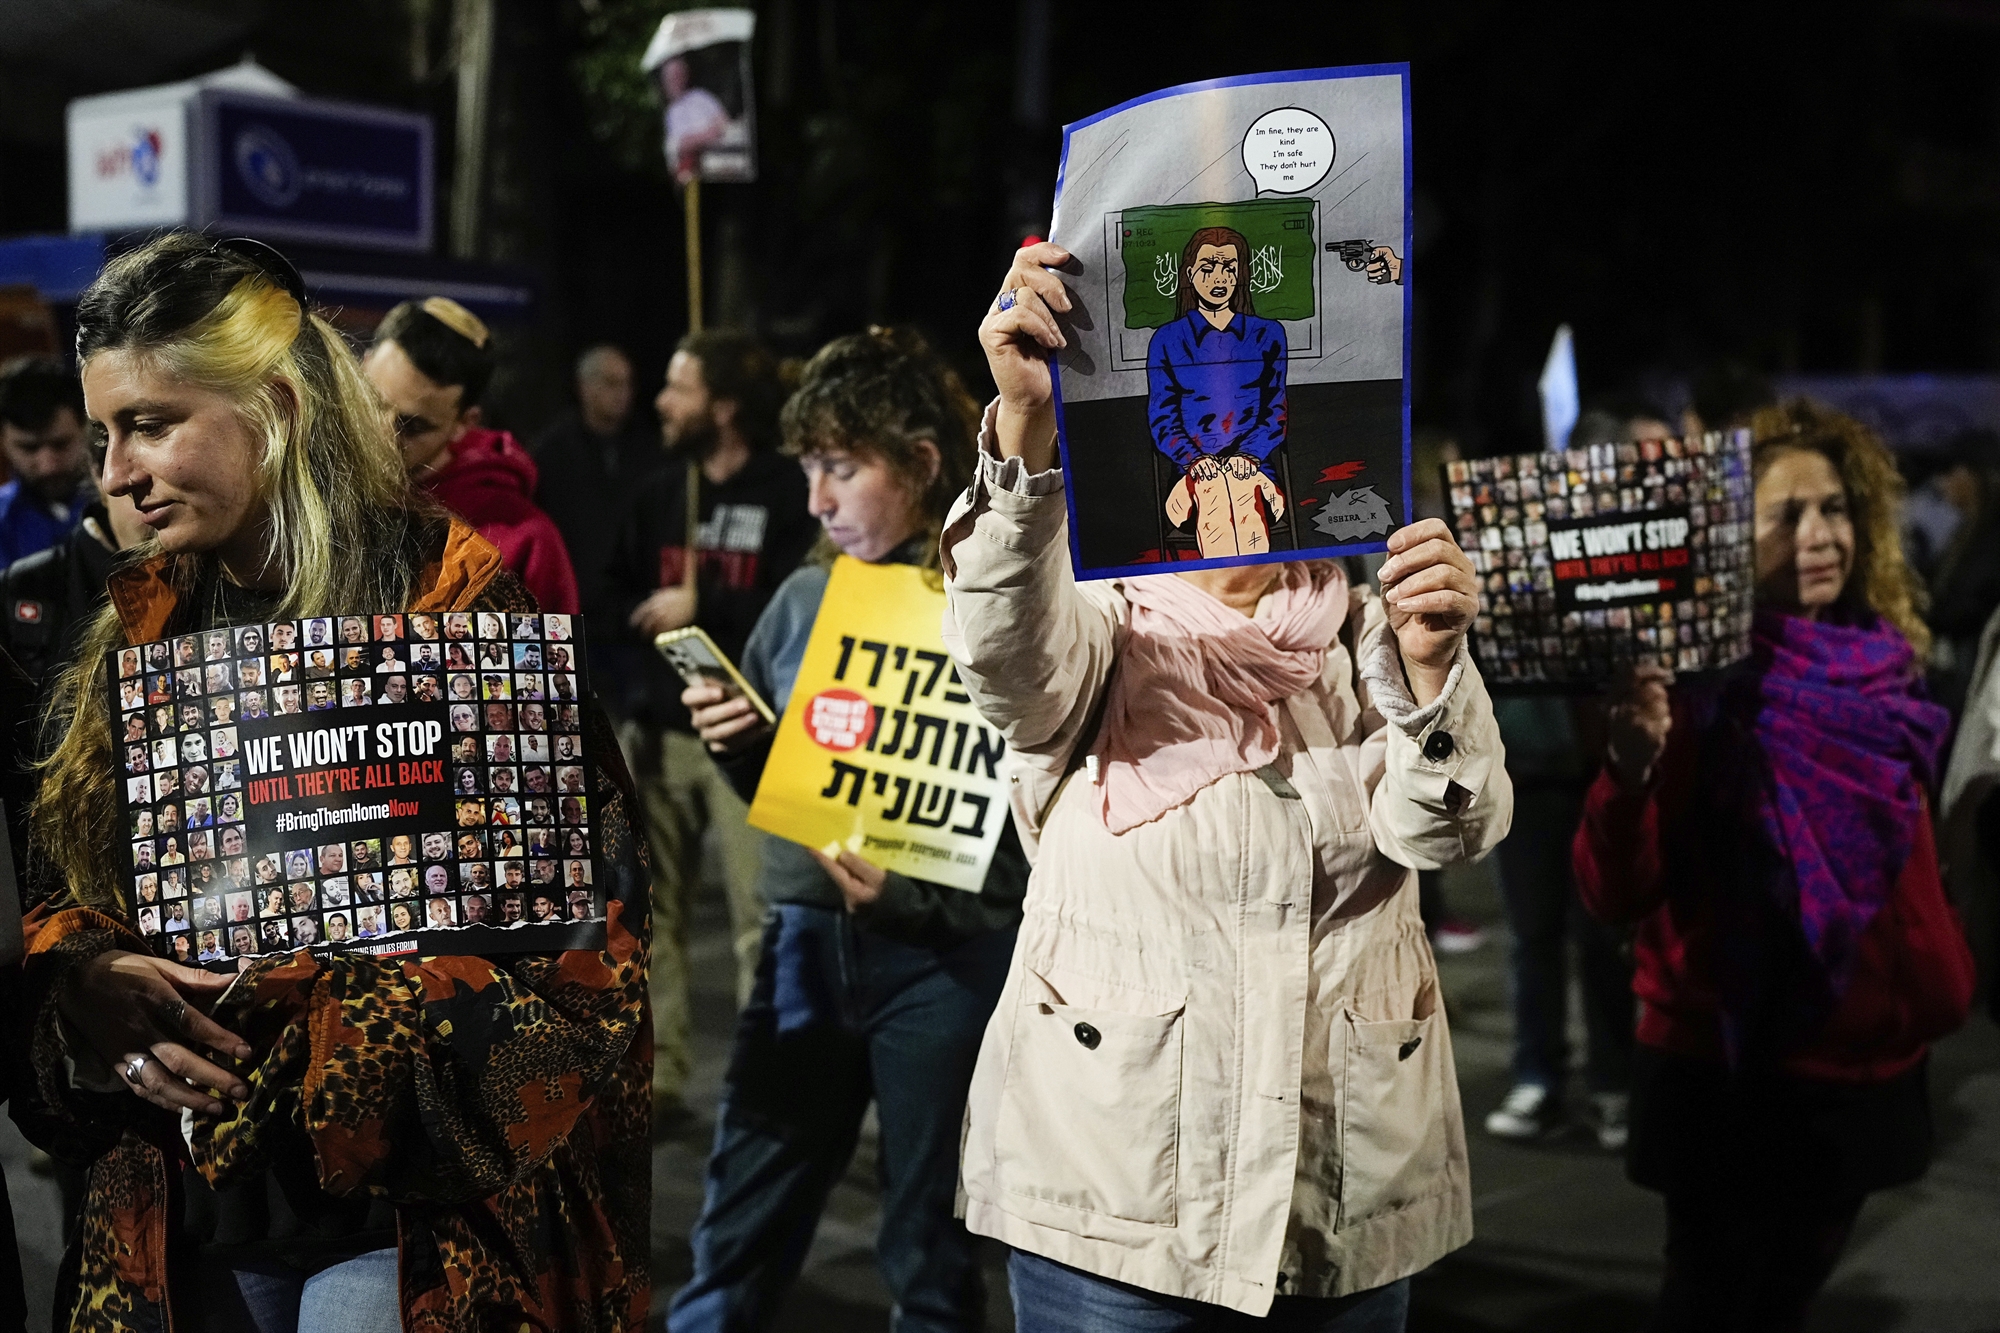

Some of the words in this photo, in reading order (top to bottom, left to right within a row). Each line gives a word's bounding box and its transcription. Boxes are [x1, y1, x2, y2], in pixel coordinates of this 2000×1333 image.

[1255, 128, 1266, 136] Im
[1268, 127, 1284, 135] fine,
[1287, 126, 1303, 134] they
[1279, 138, 1295, 146] kind
[1260, 163, 1278, 171] They
[1280, 161, 1297, 169] don't
[1300, 160, 1316, 168] hurt
[1273, 150, 1285, 158] I'm
[1287, 149, 1303, 157] safe
[1136, 228, 1153, 236] REC
[1549, 528, 1583, 561] WE
[1582, 521, 1643, 558] WON'T
[1645, 516, 1690, 550] STOP
[834, 634, 971, 706] פקירו
[244, 735, 284, 776] WE
[287, 725, 369, 769] WON'T
[376, 720, 442, 759] STOP
[866, 705, 1006, 780] אותנו
[248, 776, 293, 805] UNTIL
[295, 767, 361, 798] THEY'RE
[364, 763, 395, 789] ALL
[399, 760, 445, 786] BACK
[821, 759, 991, 839] בשנית
[275, 798, 420, 833] #BringThemHomeNow
[369, 943, 396, 956] FAMILIES
[396, 940, 418, 952] FORUM
